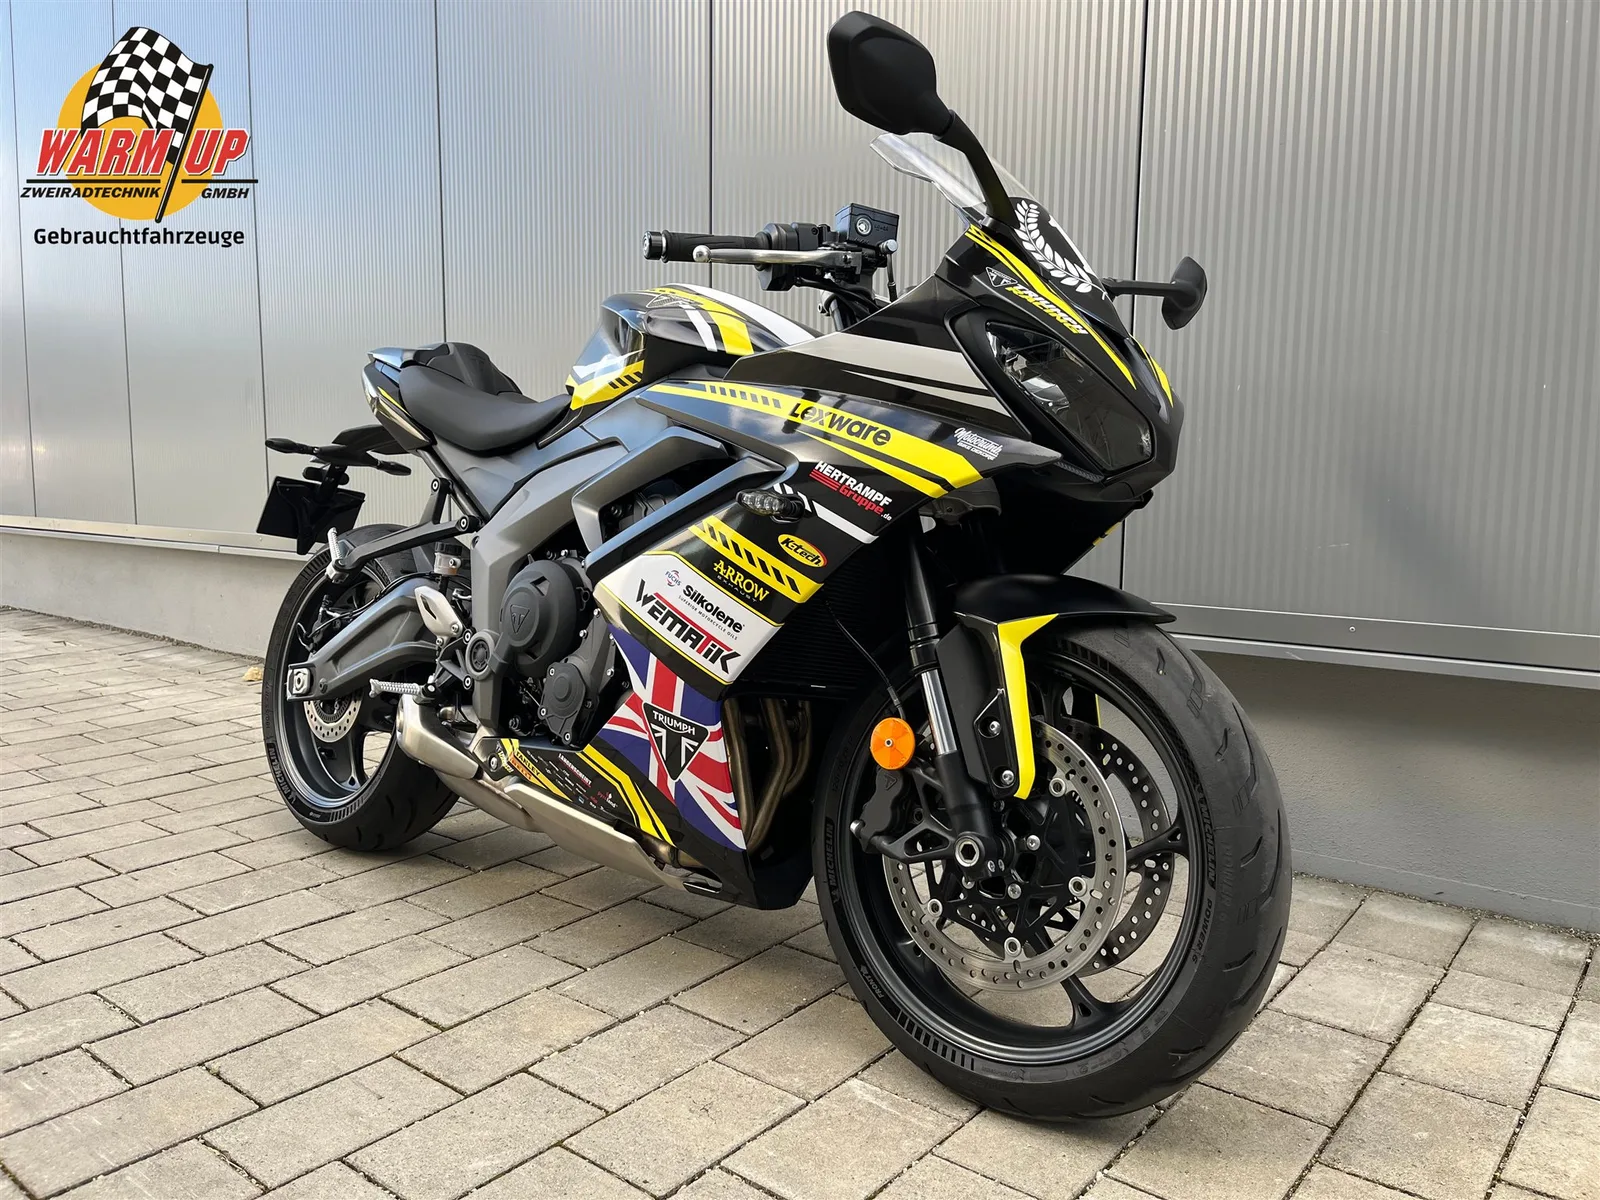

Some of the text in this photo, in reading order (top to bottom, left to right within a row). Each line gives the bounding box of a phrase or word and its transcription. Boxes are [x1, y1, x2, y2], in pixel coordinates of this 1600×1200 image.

[788, 402, 892, 446] Lexware
[814, 460, 893, 506] HERTRAMPF
[665, 571, 681, 586] FUCHS
[713, 559, 770, 602] ARROW
[717, 575, 757, 602] EXHAUST
[678, 595, 738, 640] SUPERIOR MOTORCYCLE OILS
[682, 585, 743, 633] Silkolene
[652, 710, 696, 736] TRIUMPH
[268, 747, 292, 794] MICHELIN
[825, 822, 837, 887] MICHELIN
[1199, 803, 1217, 883] MICHELIN
[1195, 899, 1214, 951] POWER
[863, 973, 885, 999] FRONT
